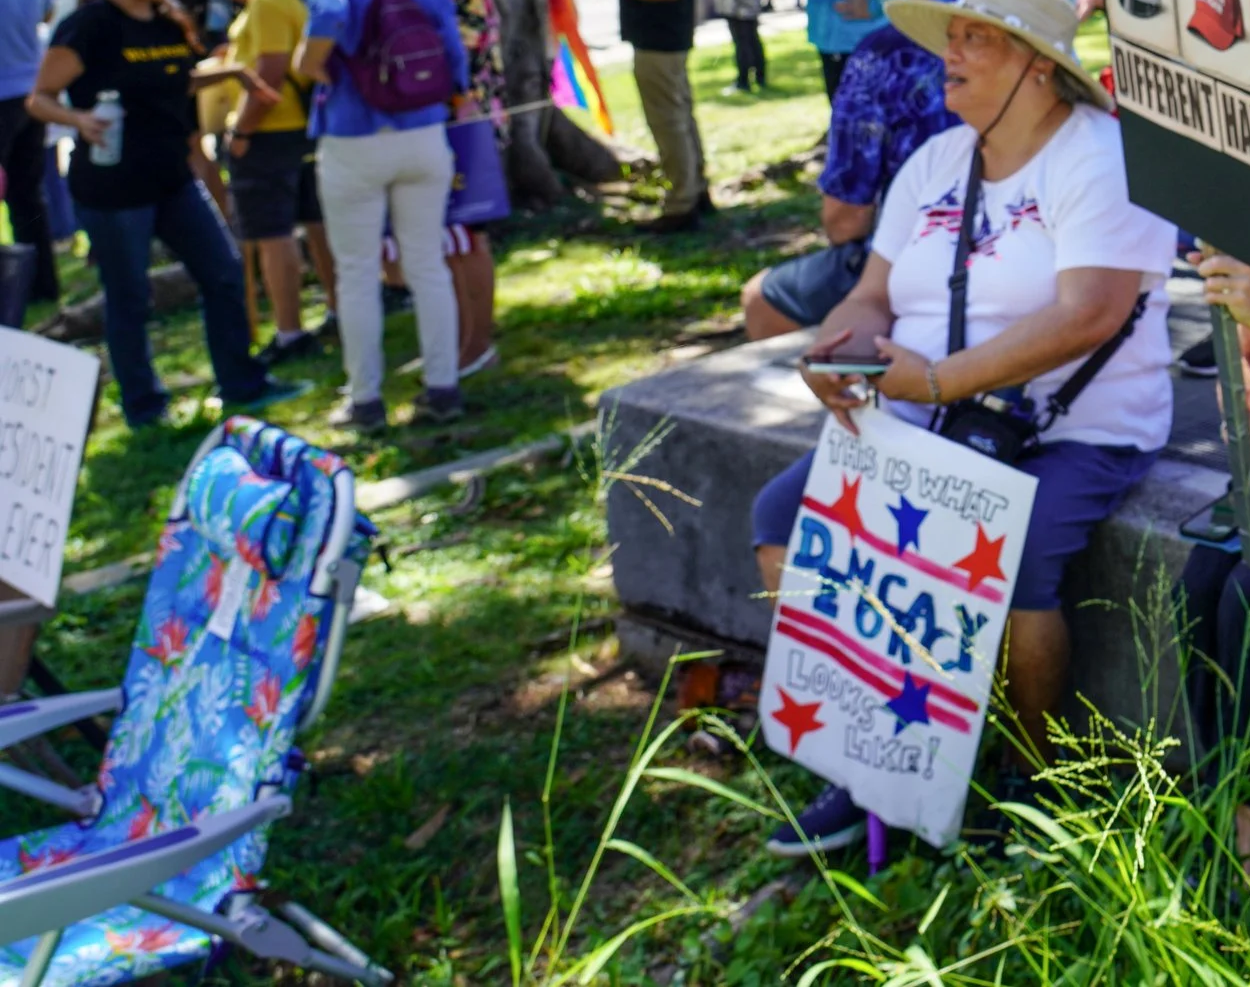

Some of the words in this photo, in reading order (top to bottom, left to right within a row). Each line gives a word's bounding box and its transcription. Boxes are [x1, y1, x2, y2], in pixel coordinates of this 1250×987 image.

[1113, 45, 1216, 139] DIFFERENT
[828, 428, 878, 481] THIS
[883, 457, 912, 493] IS
[918, 468, 1010, 525] WHAT
[1, 500, 60, 578] EVER
